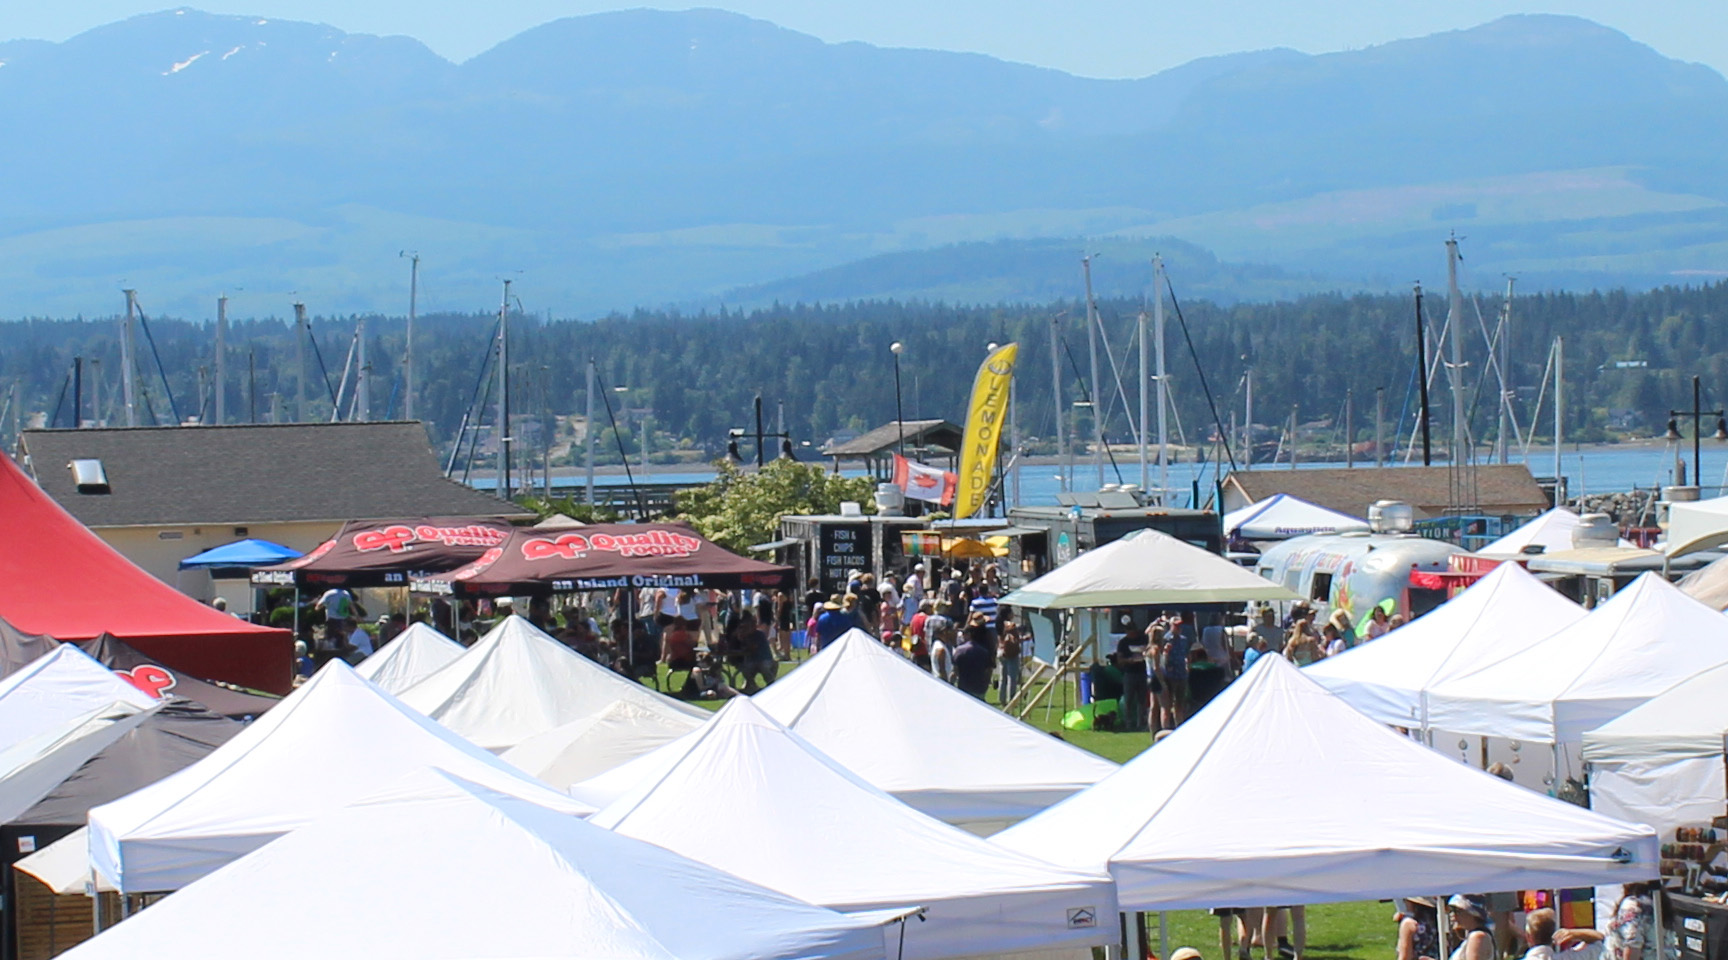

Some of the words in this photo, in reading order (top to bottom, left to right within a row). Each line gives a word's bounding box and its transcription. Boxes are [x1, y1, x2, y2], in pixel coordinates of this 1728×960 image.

[969, 376, 998, 507] LEMONADE
[589, 530, 702, 552] Quality
[843, 556, 865, 565] TACOS
[552, 579, 572, 590] an
[576, 576, 628, 589] Island
[632, 573, 704, 588] Original.
